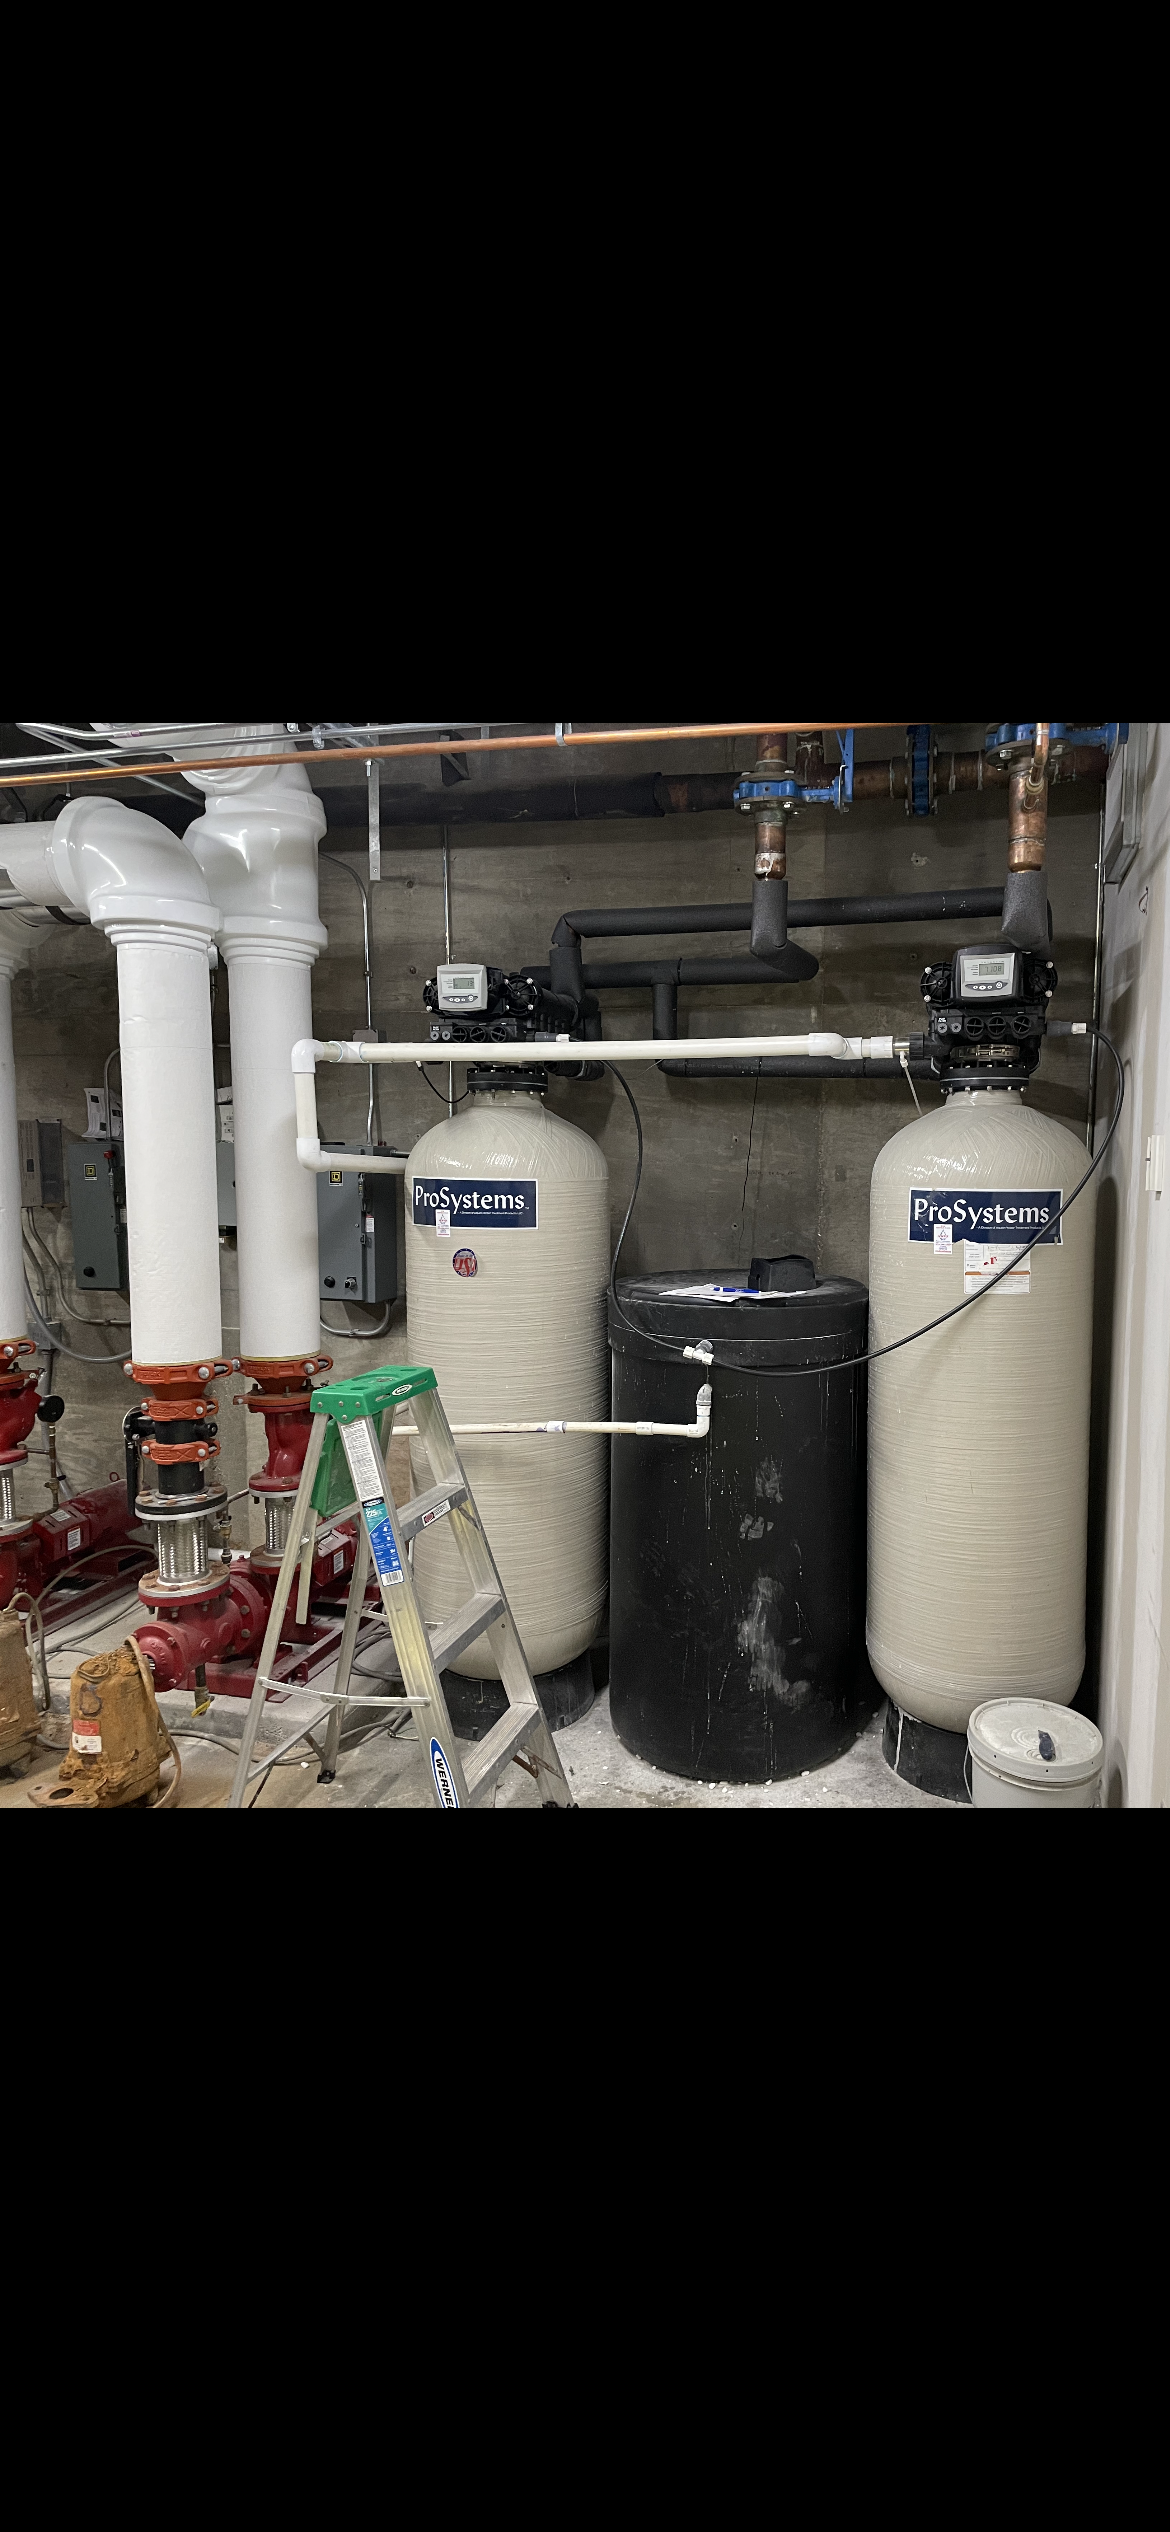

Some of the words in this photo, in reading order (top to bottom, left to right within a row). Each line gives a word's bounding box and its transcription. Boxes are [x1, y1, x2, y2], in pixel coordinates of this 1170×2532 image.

[415, 1185, 525, 1214] ProSystems
[914, 1198, 1050, 1230] ProSystems
[435, 1758, 455, 1809] WERNE
